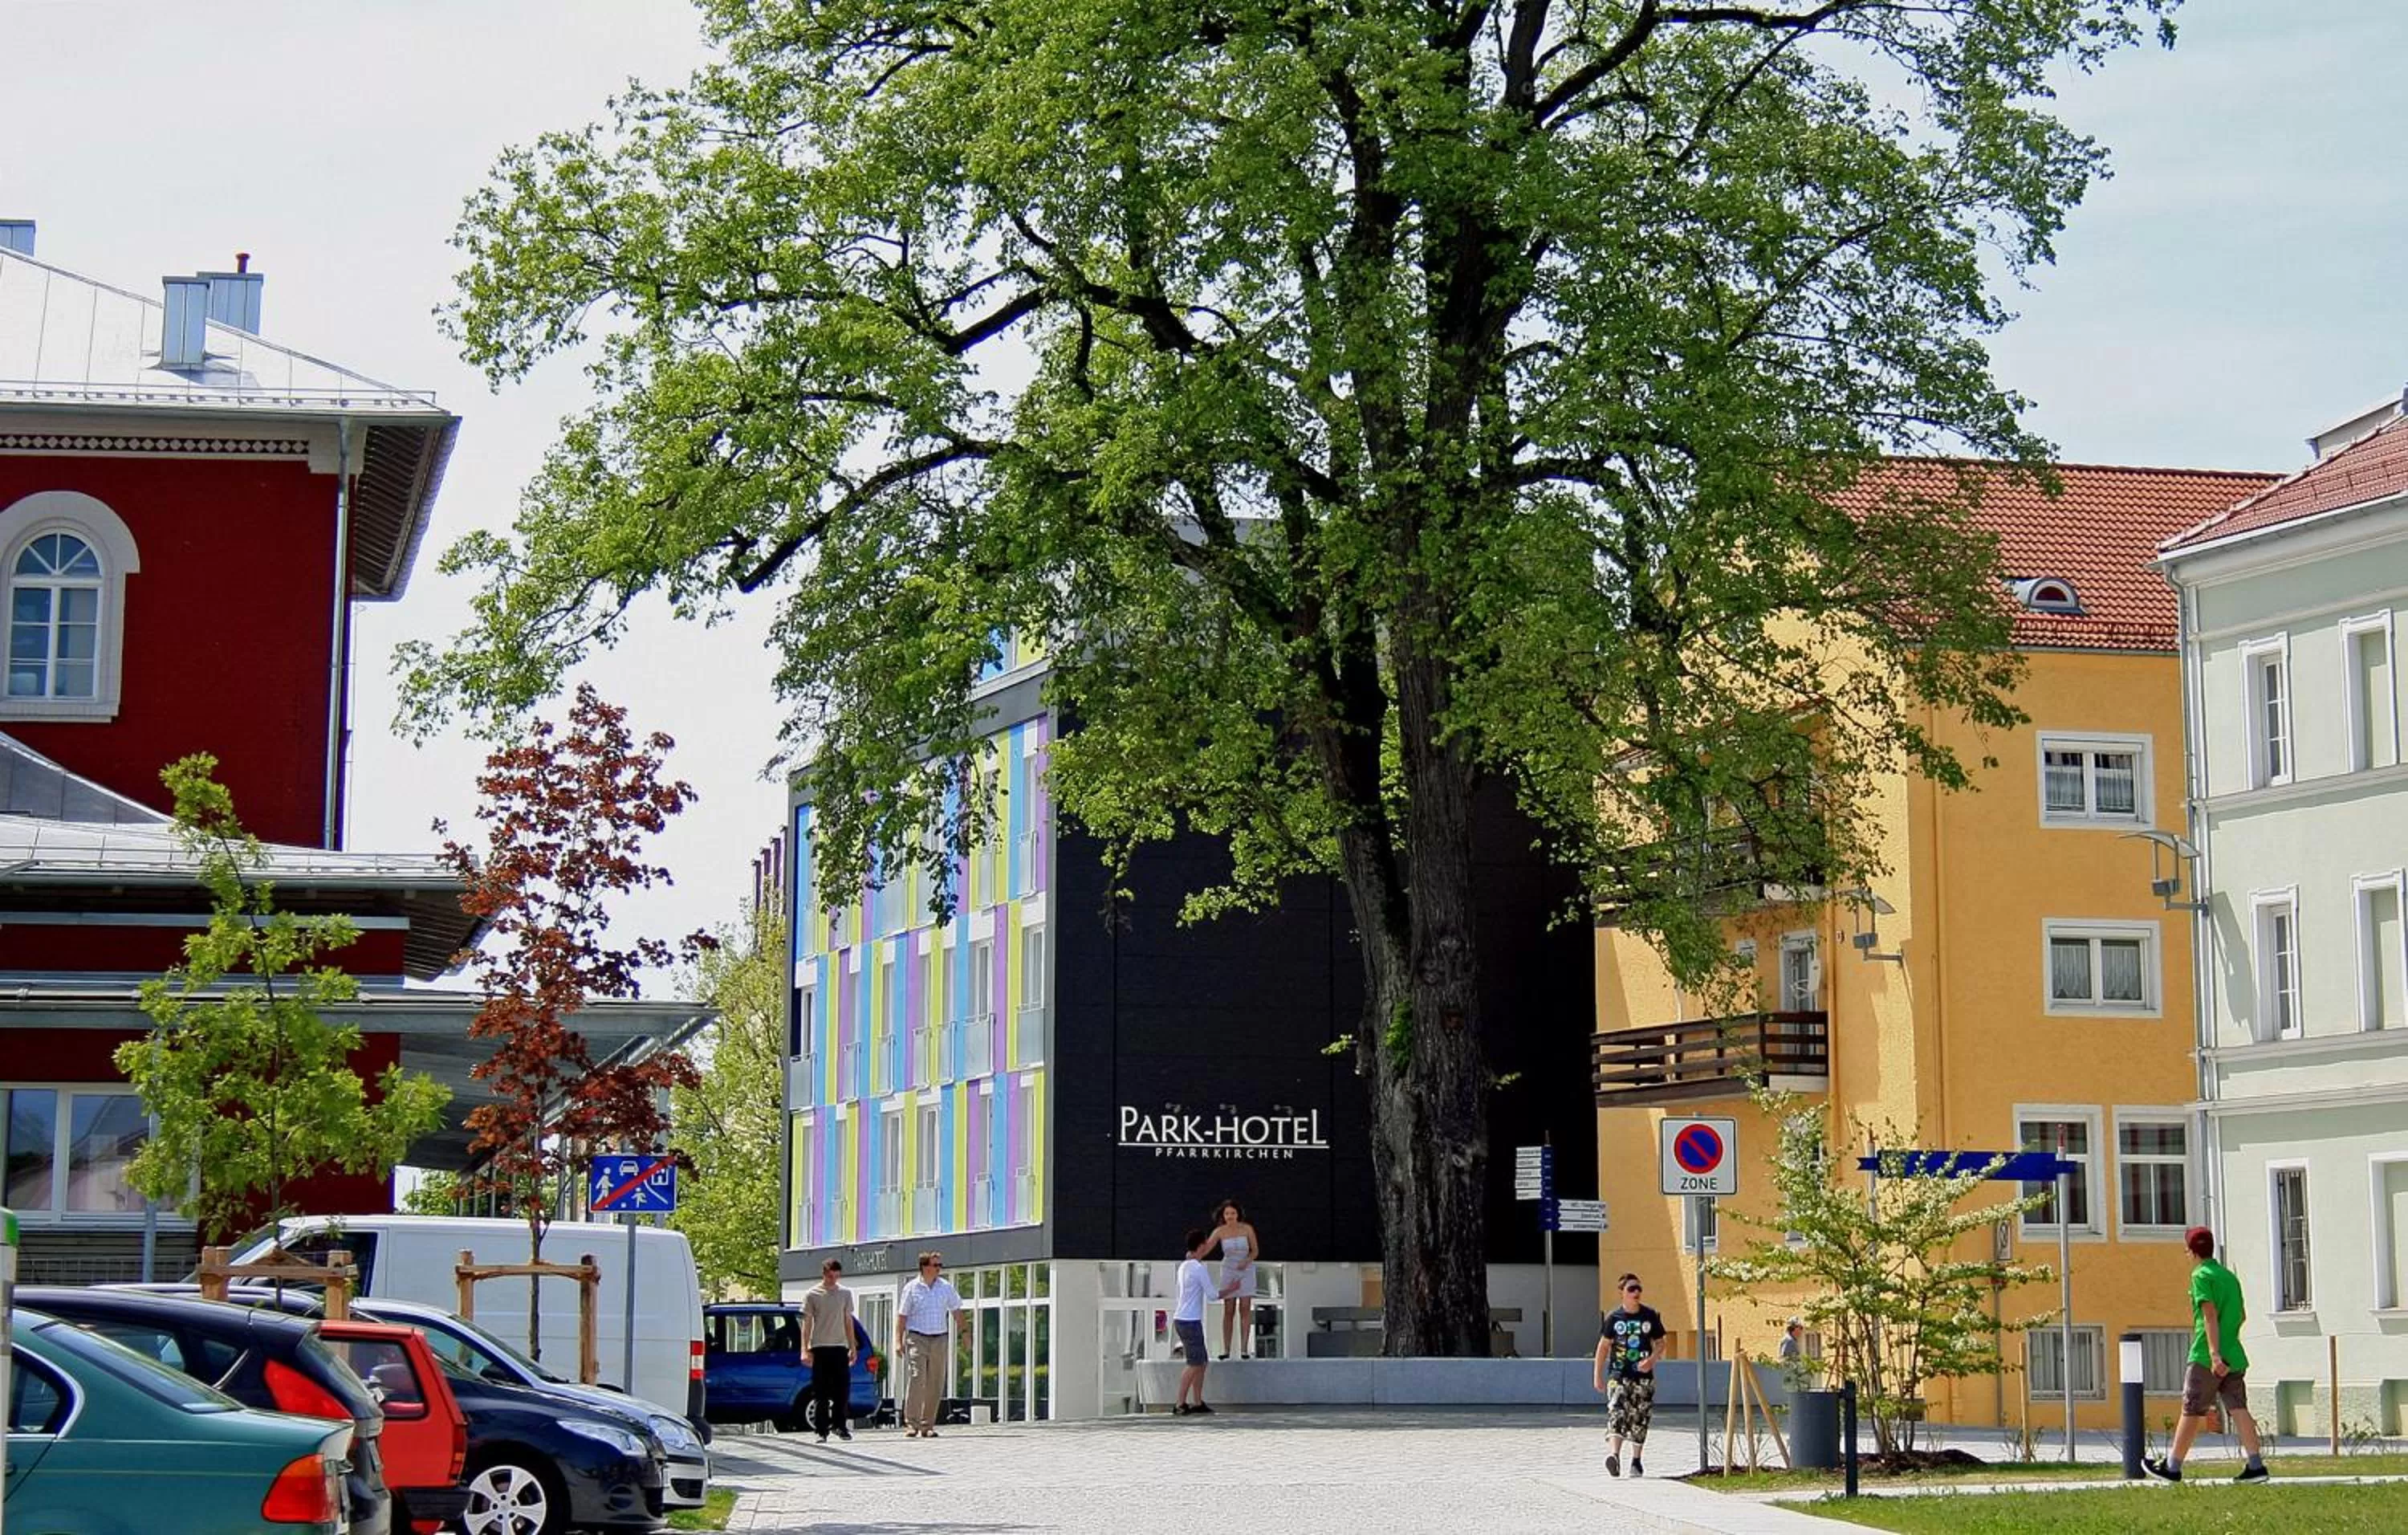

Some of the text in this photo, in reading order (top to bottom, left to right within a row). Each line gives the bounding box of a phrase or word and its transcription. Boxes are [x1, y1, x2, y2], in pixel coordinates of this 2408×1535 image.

[1121, 1105, 1327, 1144] PARK-HOTEL
[1155, 1147, 1293, 1159] PFARRKIRCHEN
[1680, 1177, 1718, 1190] ZONE
